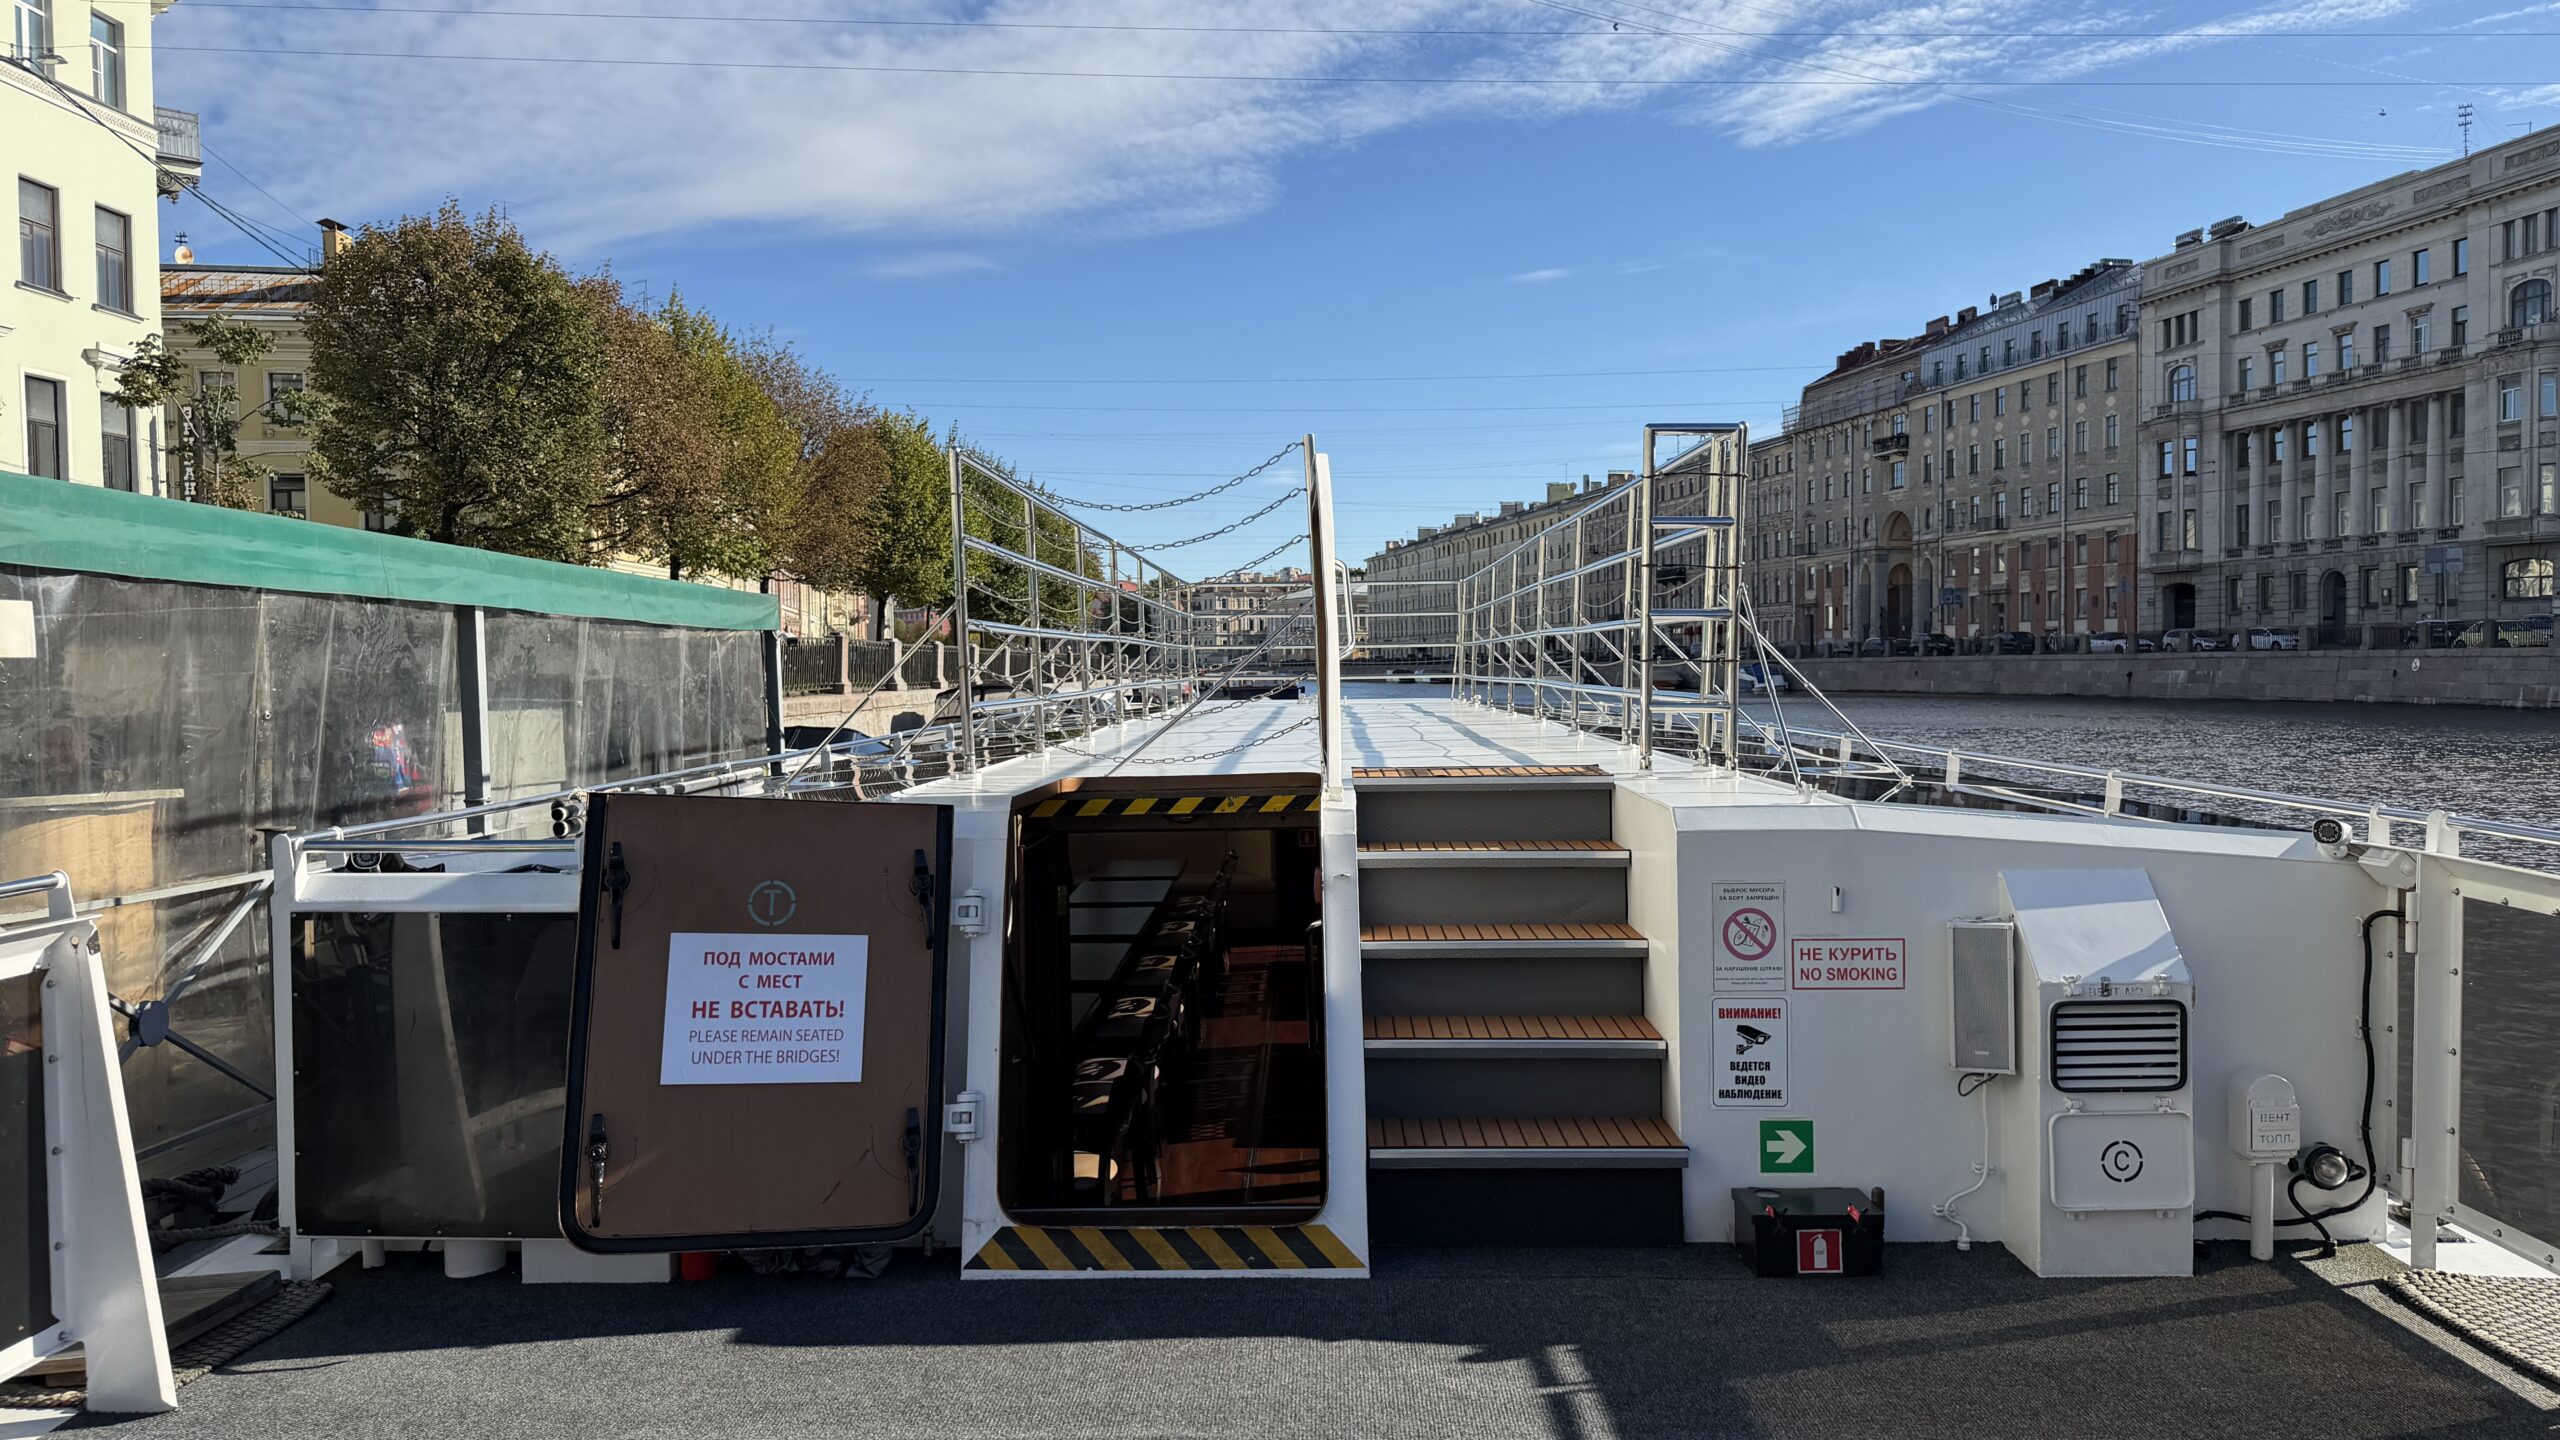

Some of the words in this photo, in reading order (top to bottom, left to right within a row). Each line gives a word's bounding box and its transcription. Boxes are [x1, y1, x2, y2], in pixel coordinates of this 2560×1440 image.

[704, 951, 741, 968] ПОД
[749, 951, 835, 966] МОСТАМИ
[1800, 947, 1823, 961] НЕ
[1829, 947, 1897, 961] КУРИТЬ
[1800, 967, 1822, 981] NO
[1826, 967, 1898, 981] SMOKING
[738, 974, 749, 989] С
[756, 974, 803, 989] МЕСТ
[2088, 986, 2120, 997] ВЕТ
[691, 1000, 720, 1019] НЕ
[730, 1000, 845, 1019] ВСТАВАТЬ!
[1718, 1007, 1781, 1019] ВНИМАНИЕ!
[689, 1029, 737, 1043] PLEASE
[741, 1029, 792, 1042] REMAIN
[796, 1028, 844, 1042] SEATED
[691, 1050, 742, 1065] UNDER
[746, 1050, 772, 1064] THE
[776, 1049, 840, 1063] BRIDGES!
[1729, 1061, 1770, 1072] ВЕДЕТСЯ
[1734, 1075, 1766, 1086] ВИДЕО
[1718, 1089, 1782, 1101] НАБЛЮДЕНИЕ
[2260, 1113, 2291, 1123] ВЕНТ
[2259, 1133, 2294, 1144] ТОПЛ.
